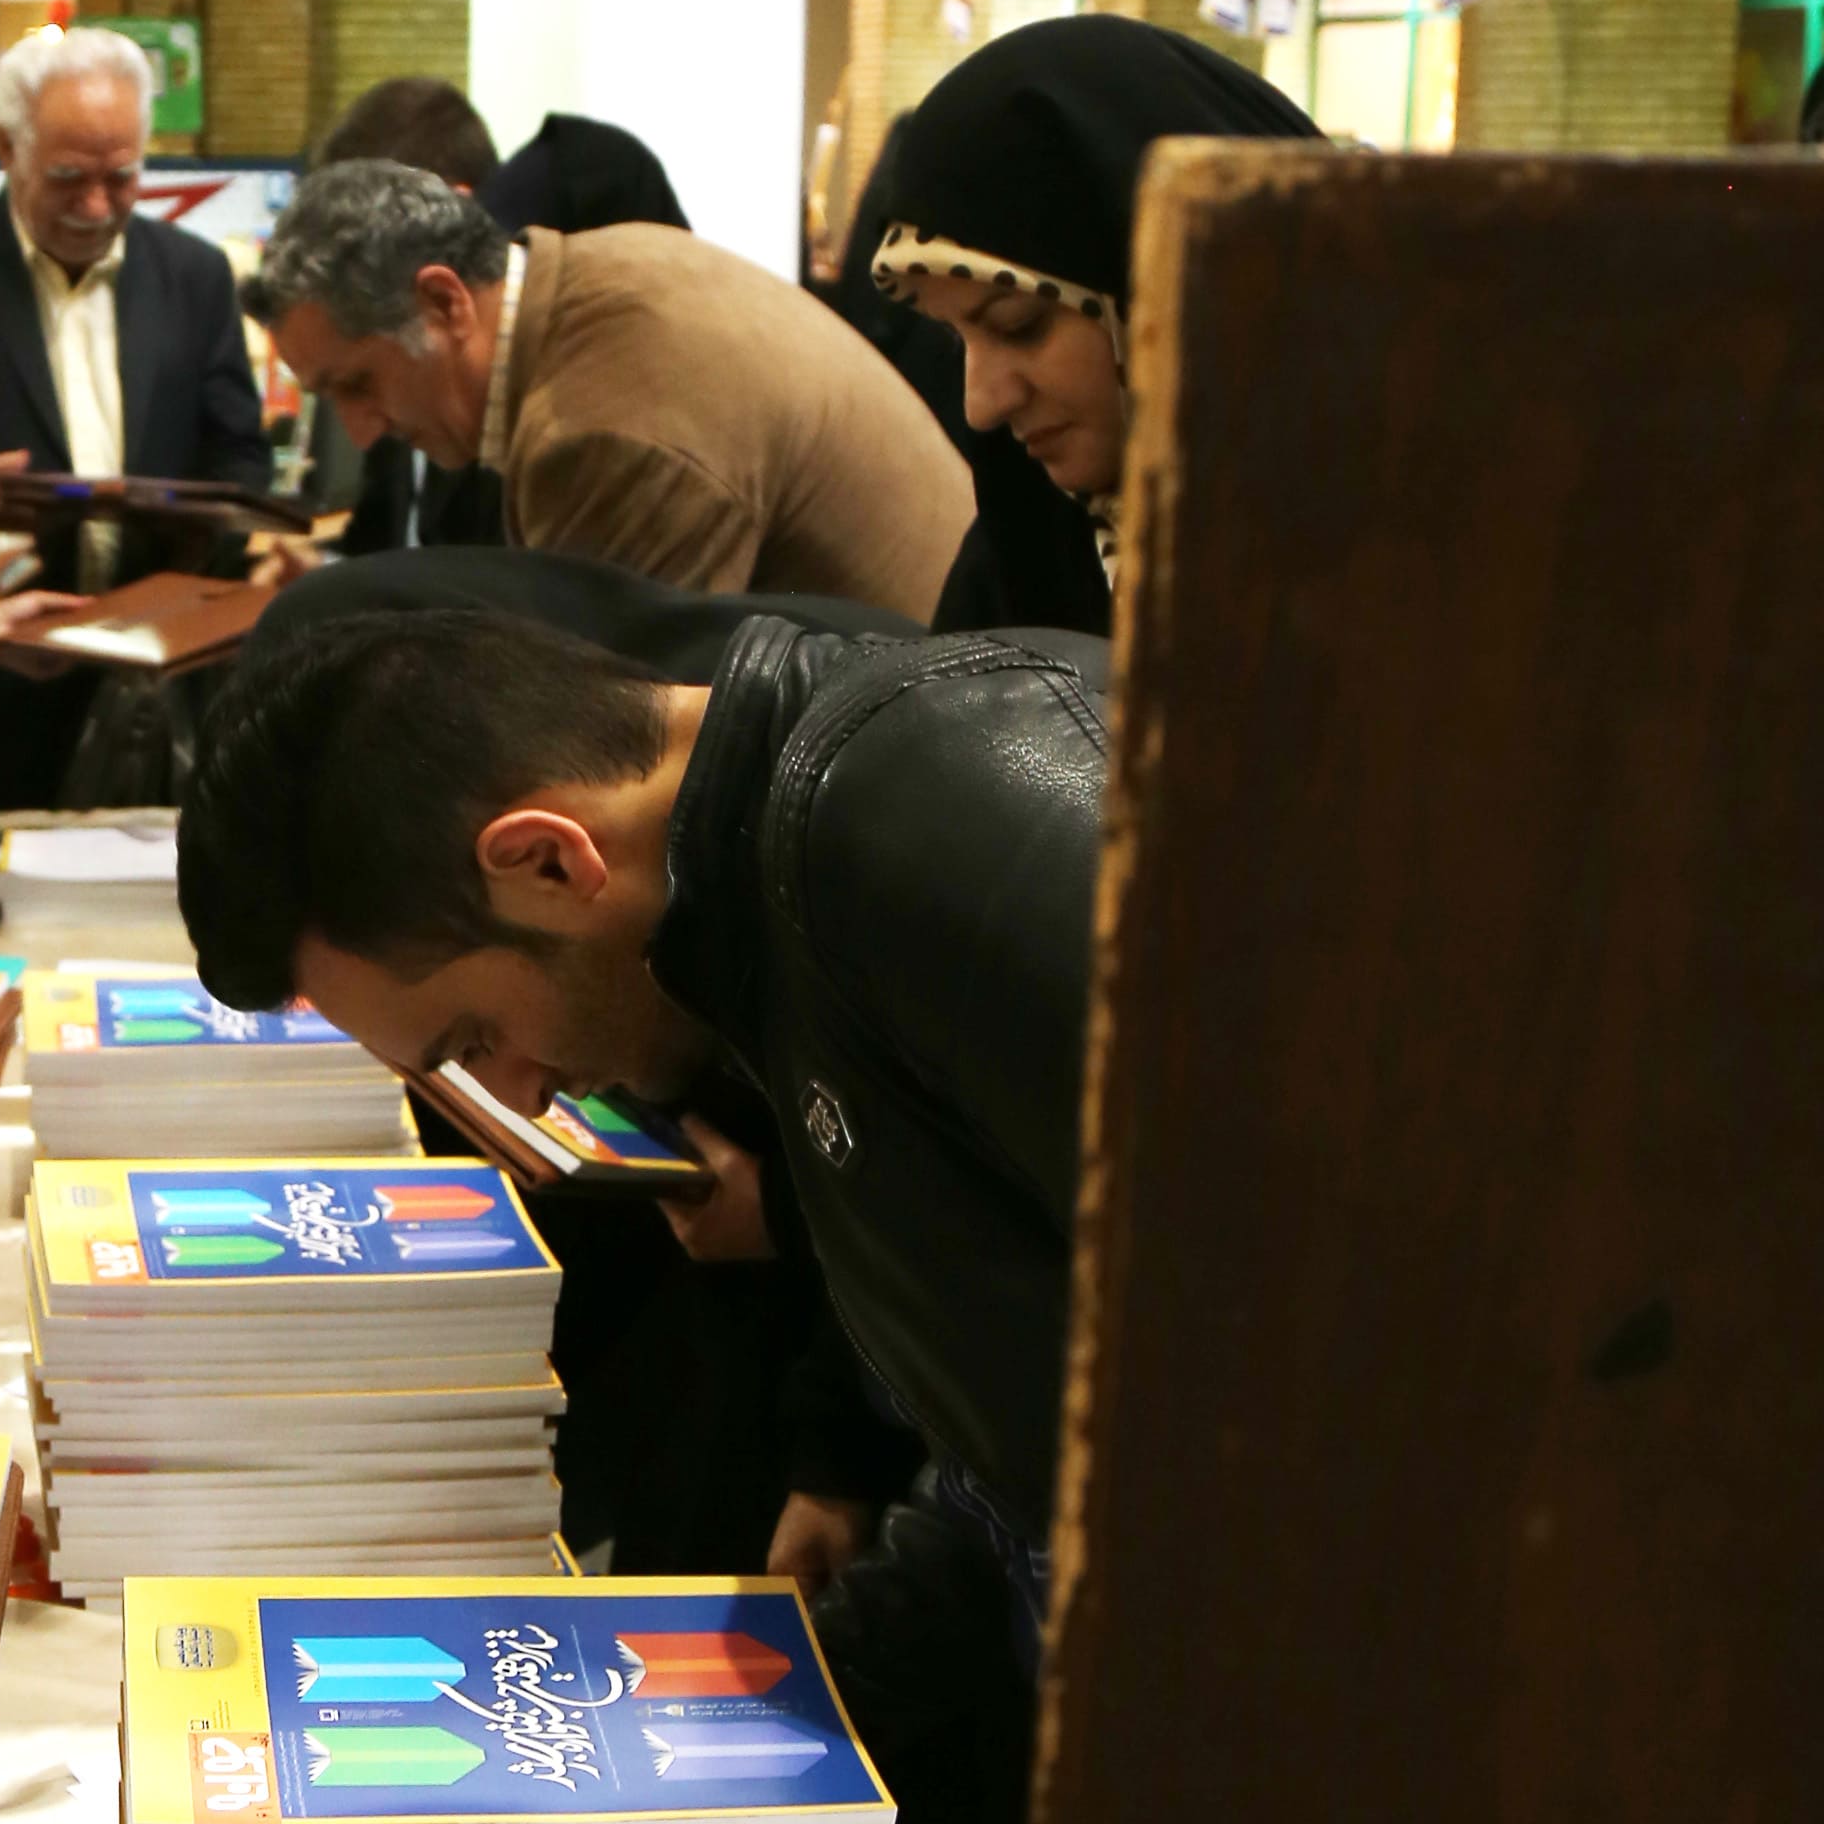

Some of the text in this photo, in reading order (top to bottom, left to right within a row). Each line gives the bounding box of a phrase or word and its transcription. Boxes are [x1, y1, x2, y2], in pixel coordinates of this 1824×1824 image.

[483, 1624, 624, 1708] شانزدهمین
[491, 1680, 596, 1756] جشنواره
[201, 1737, 269, 1811] جوانه
